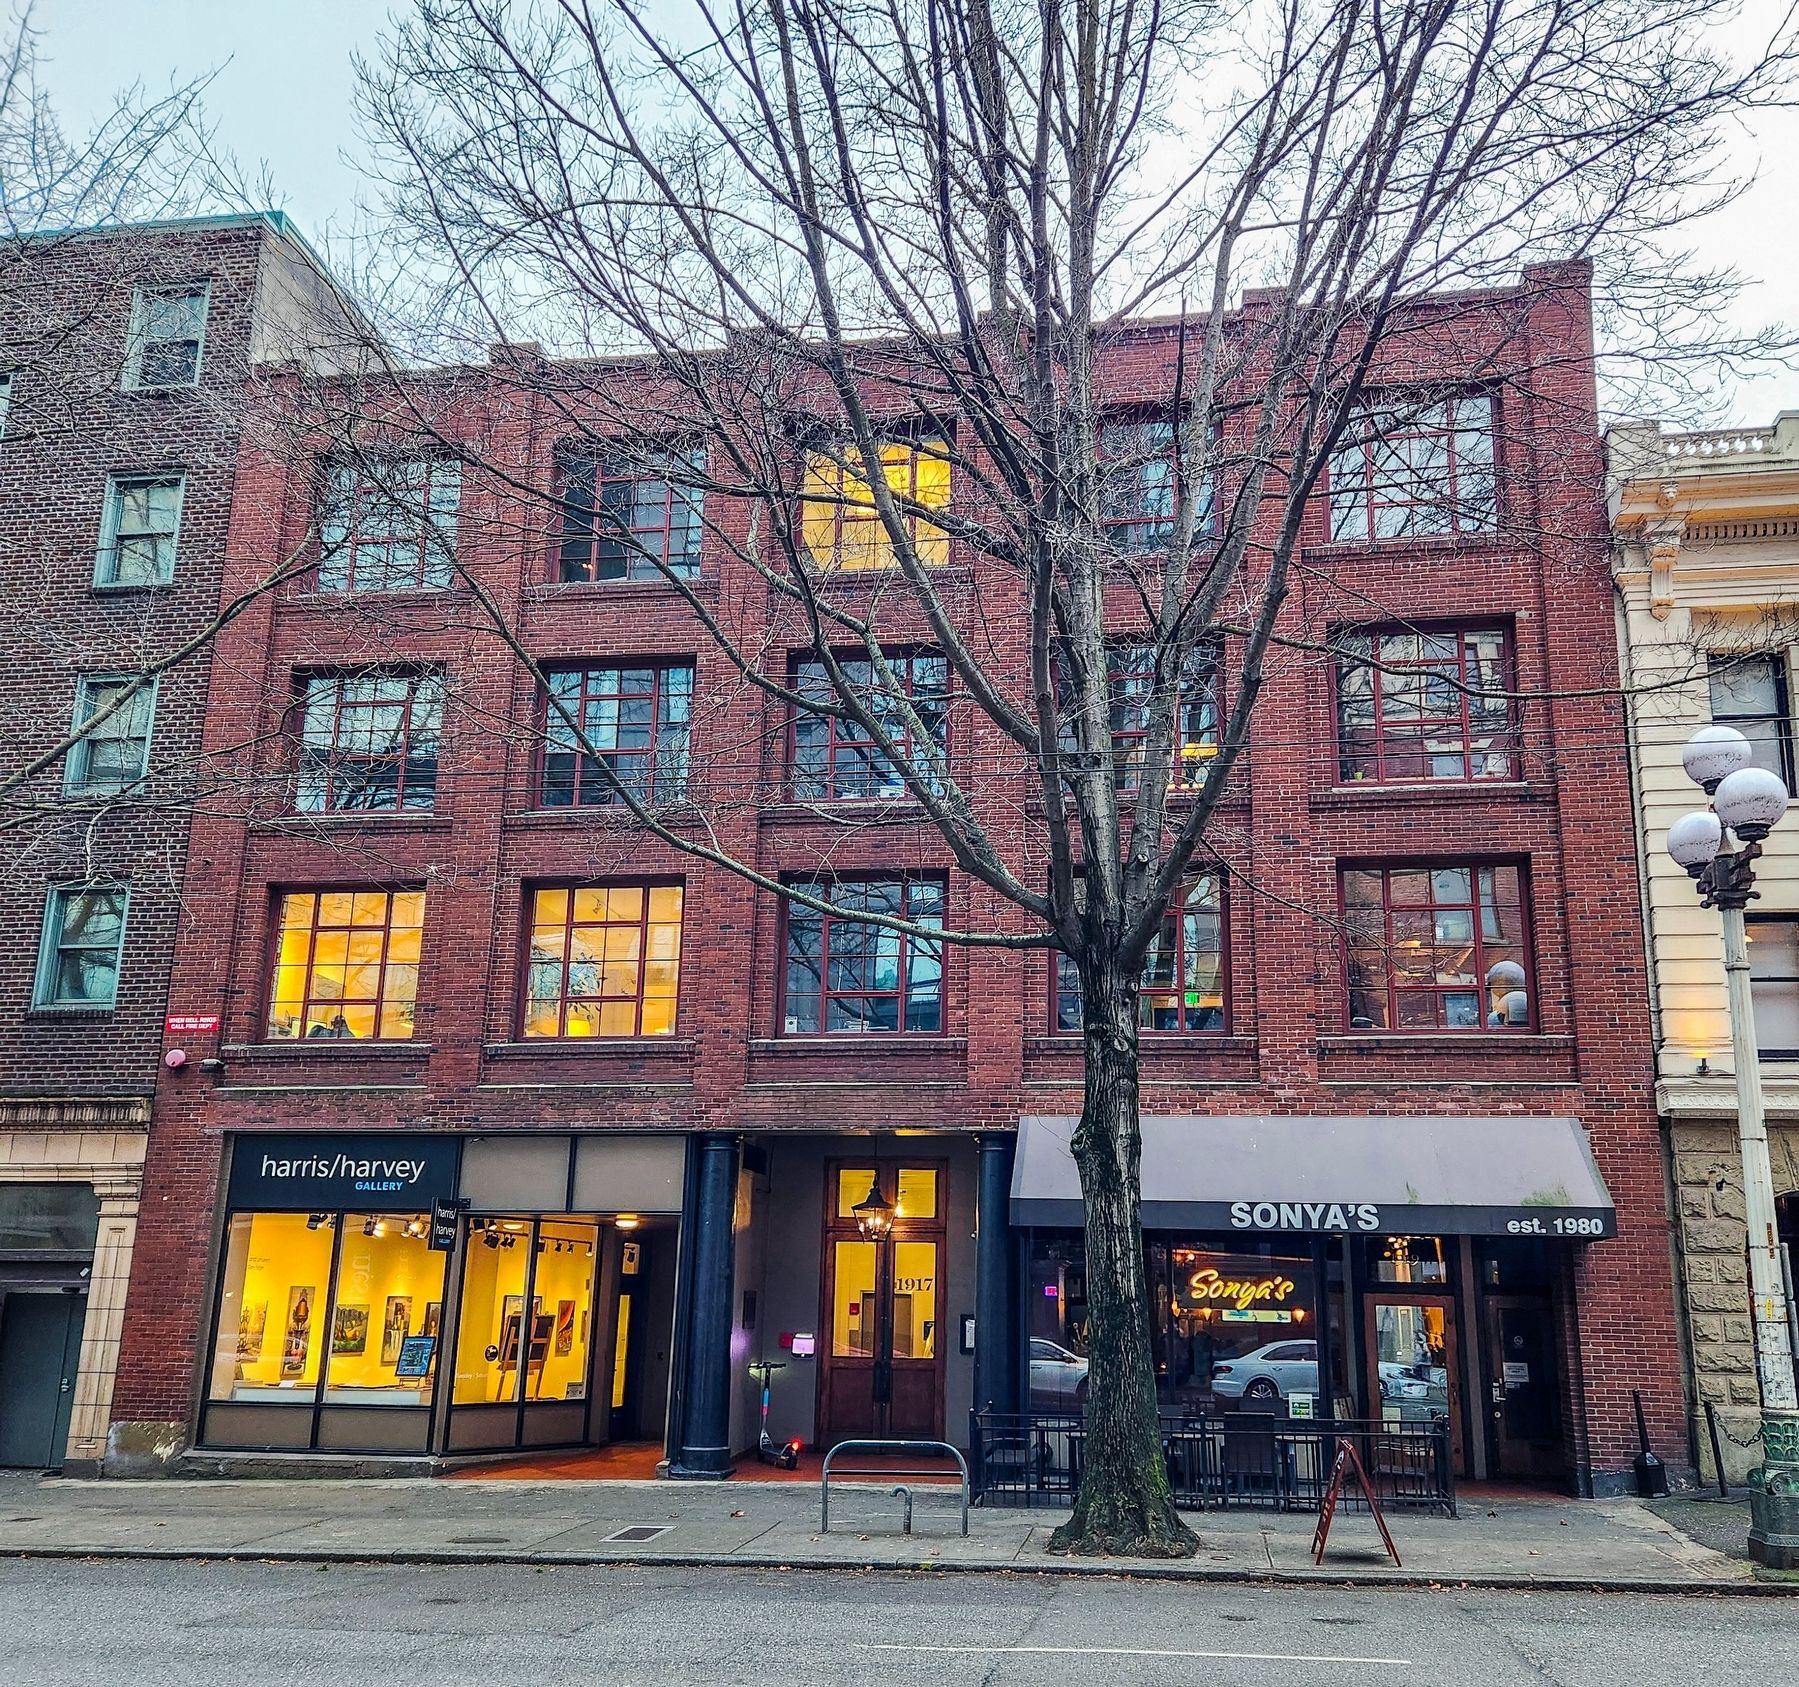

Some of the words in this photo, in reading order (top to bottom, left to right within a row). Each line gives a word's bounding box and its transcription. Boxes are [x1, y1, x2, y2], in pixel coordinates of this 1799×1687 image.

[261, 1154, 426, 1183] harris/harvey
[355, 1181, 403, 1191] GALLERY
[1230, 1201, 1380, 1231] SONYA'S
[436, 1222, 456, 1239] harvey
[1507, 1218, 1547, 1234] est.
[1553, 1217, 1604, 1235] 1980
[896, 1278, 934, 1291] 1917
[1189, 1268, 1295, 1310] Sonya's
